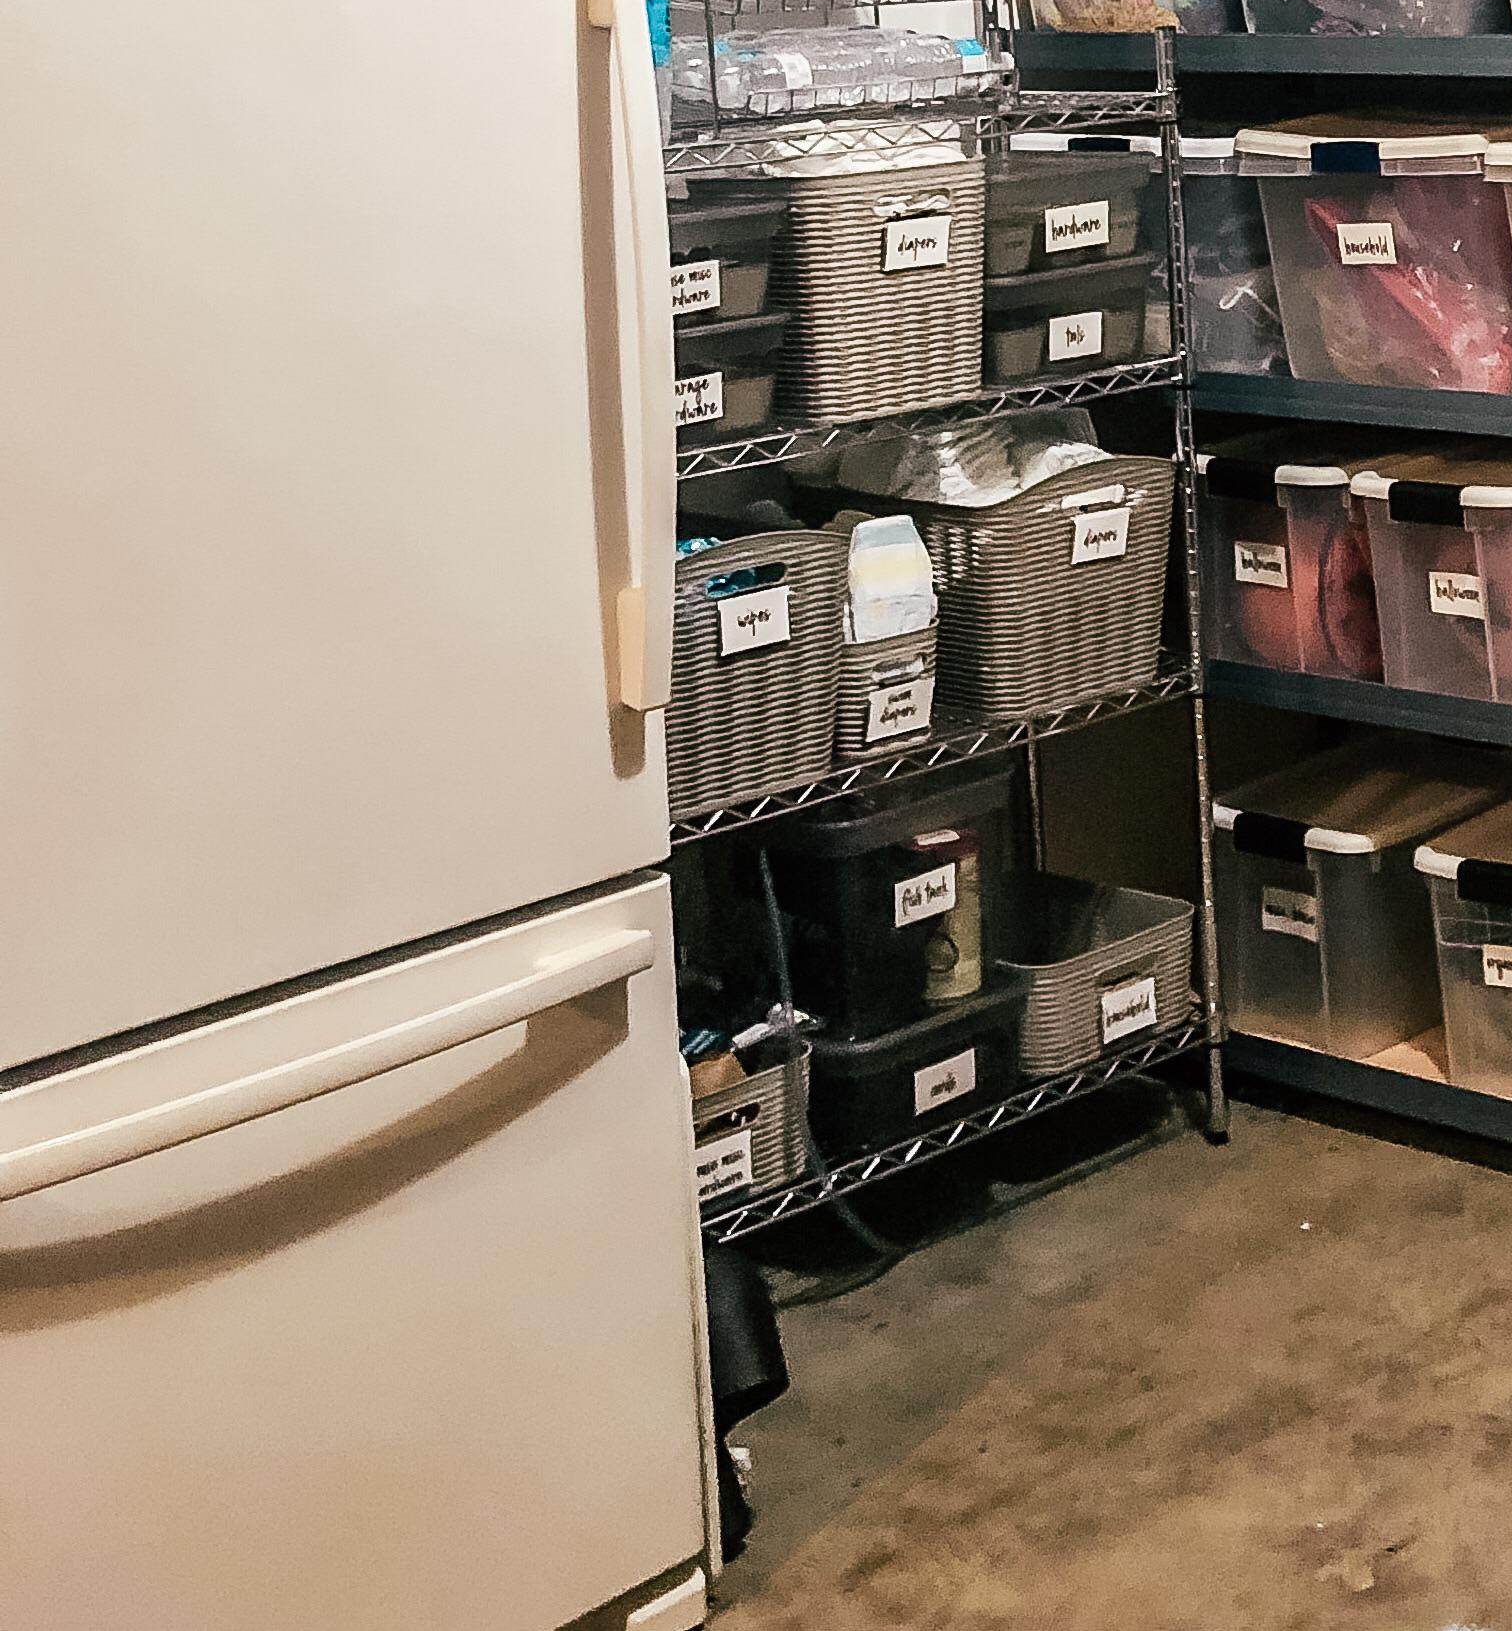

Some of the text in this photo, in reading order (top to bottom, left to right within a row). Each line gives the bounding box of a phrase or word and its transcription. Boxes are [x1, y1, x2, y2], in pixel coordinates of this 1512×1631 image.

[1050, 214, 1102, 242] hardware
[896, 232, 937, 261] diapers
[1343, 234, 1390, 257] household
[672, 288, 710, 309] rdware
